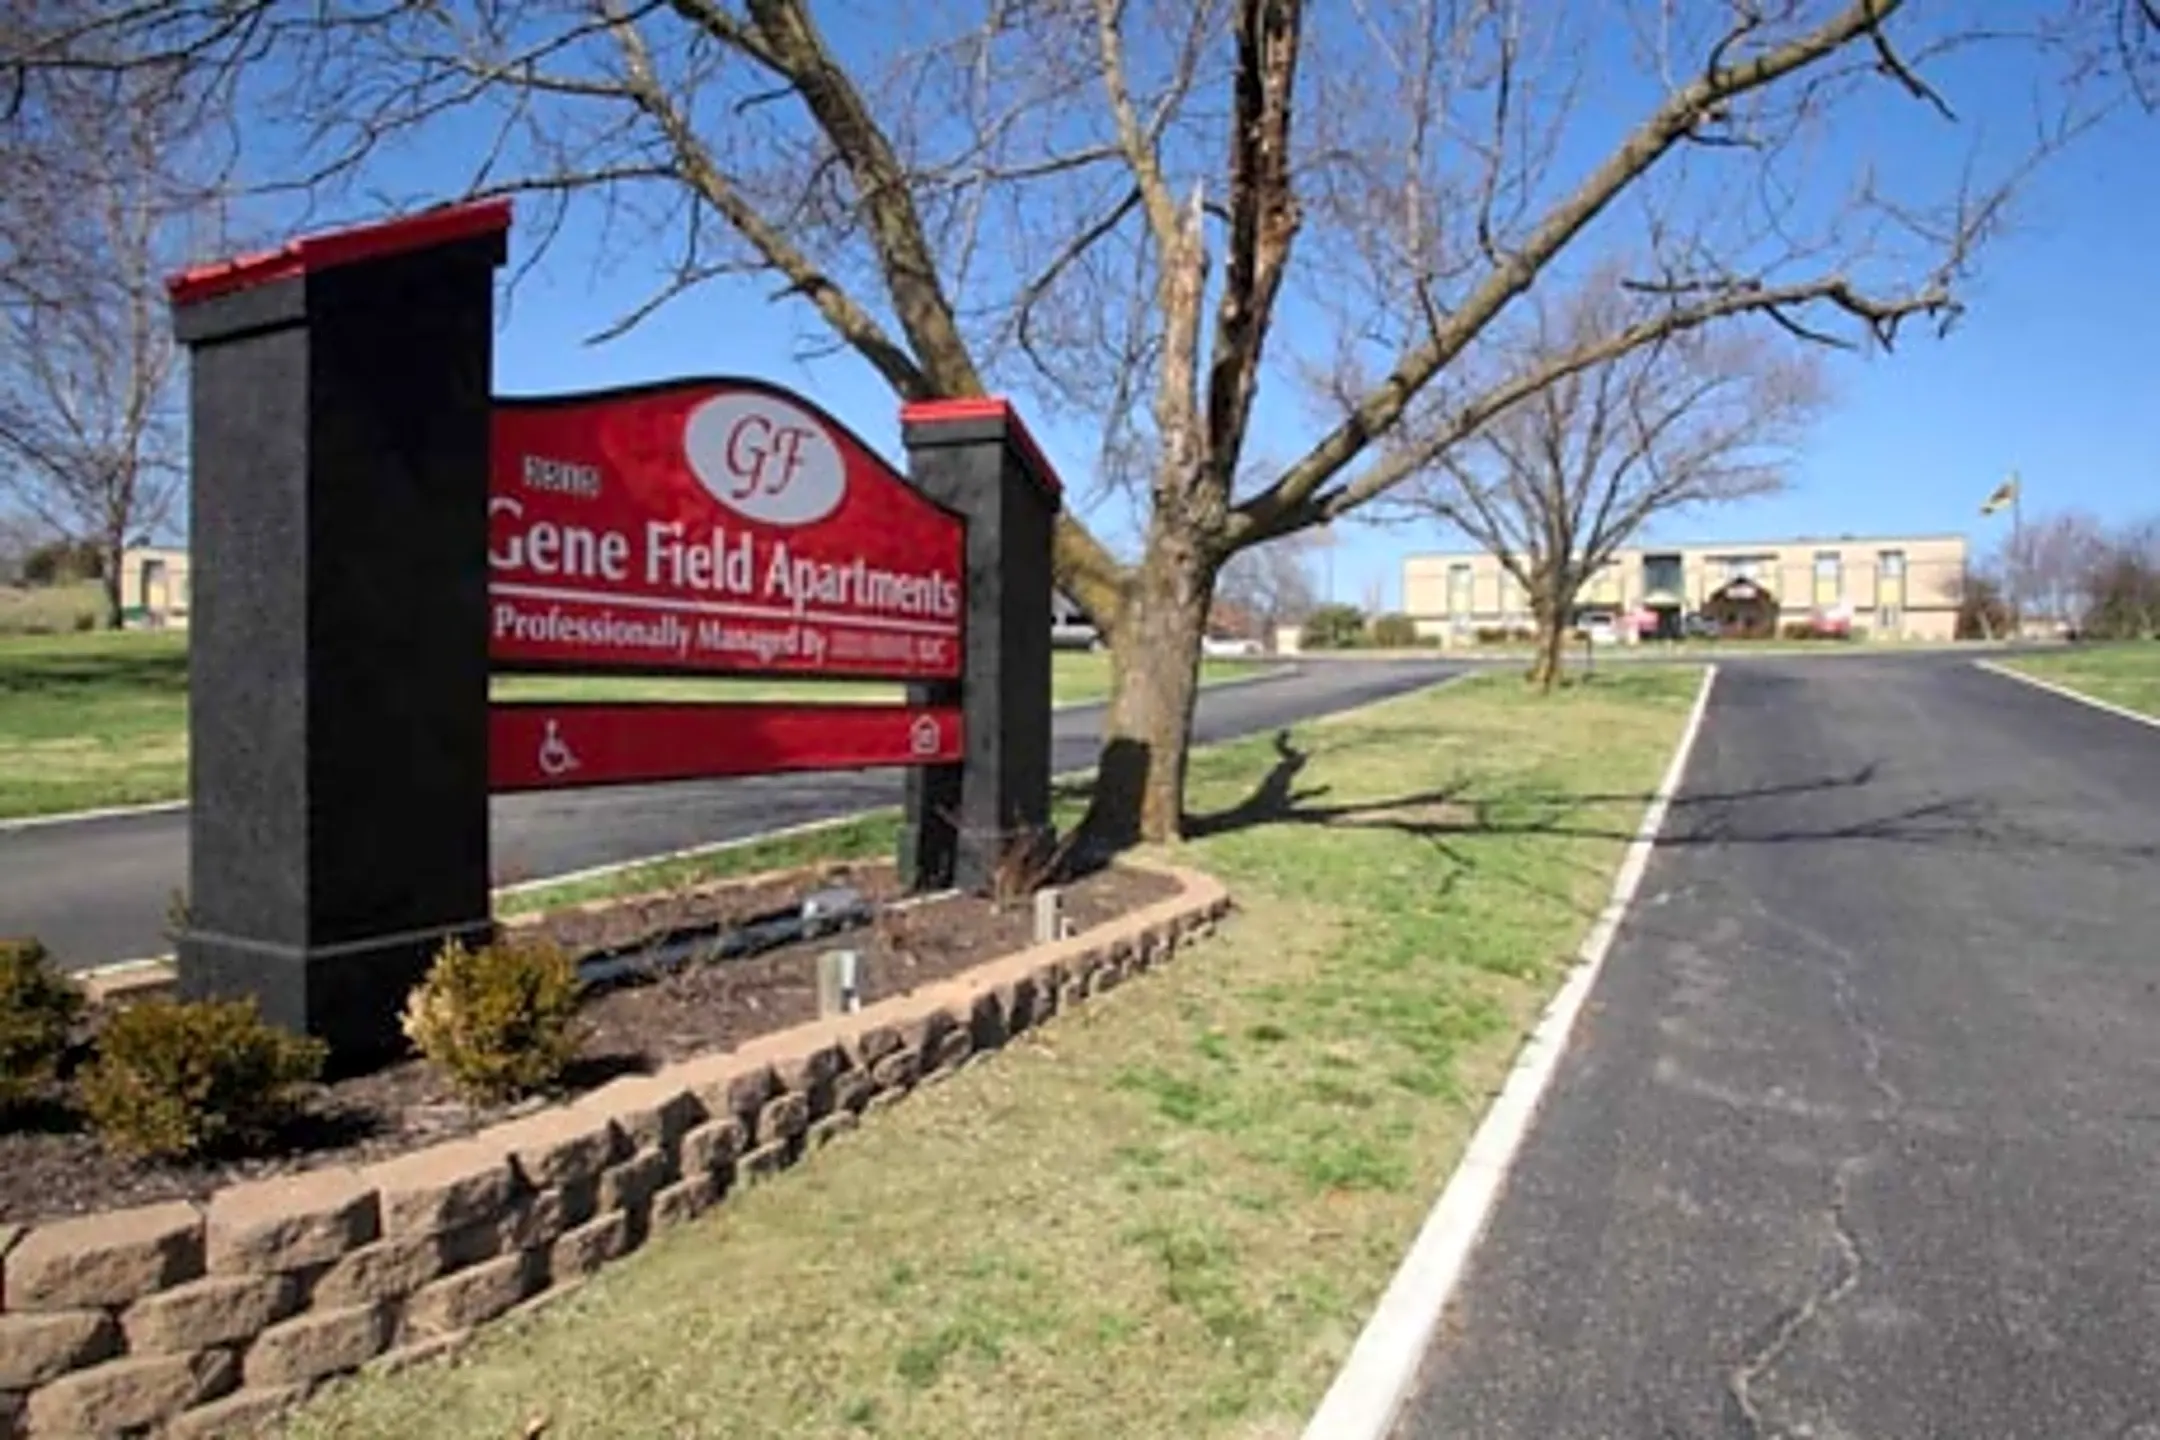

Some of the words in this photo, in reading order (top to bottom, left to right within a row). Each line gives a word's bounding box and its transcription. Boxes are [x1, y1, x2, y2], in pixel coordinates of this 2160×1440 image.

[725, 414, 814, 499] GF
[488, 498, 630, 581] Gene
[645, 521, 752, 595] Field
[764, 541, 958, 616] Apartments
[493, 604, 690, 657] Professionally
[698, 621, 798, 663] Managed
[801, 626, 827, 665] By
